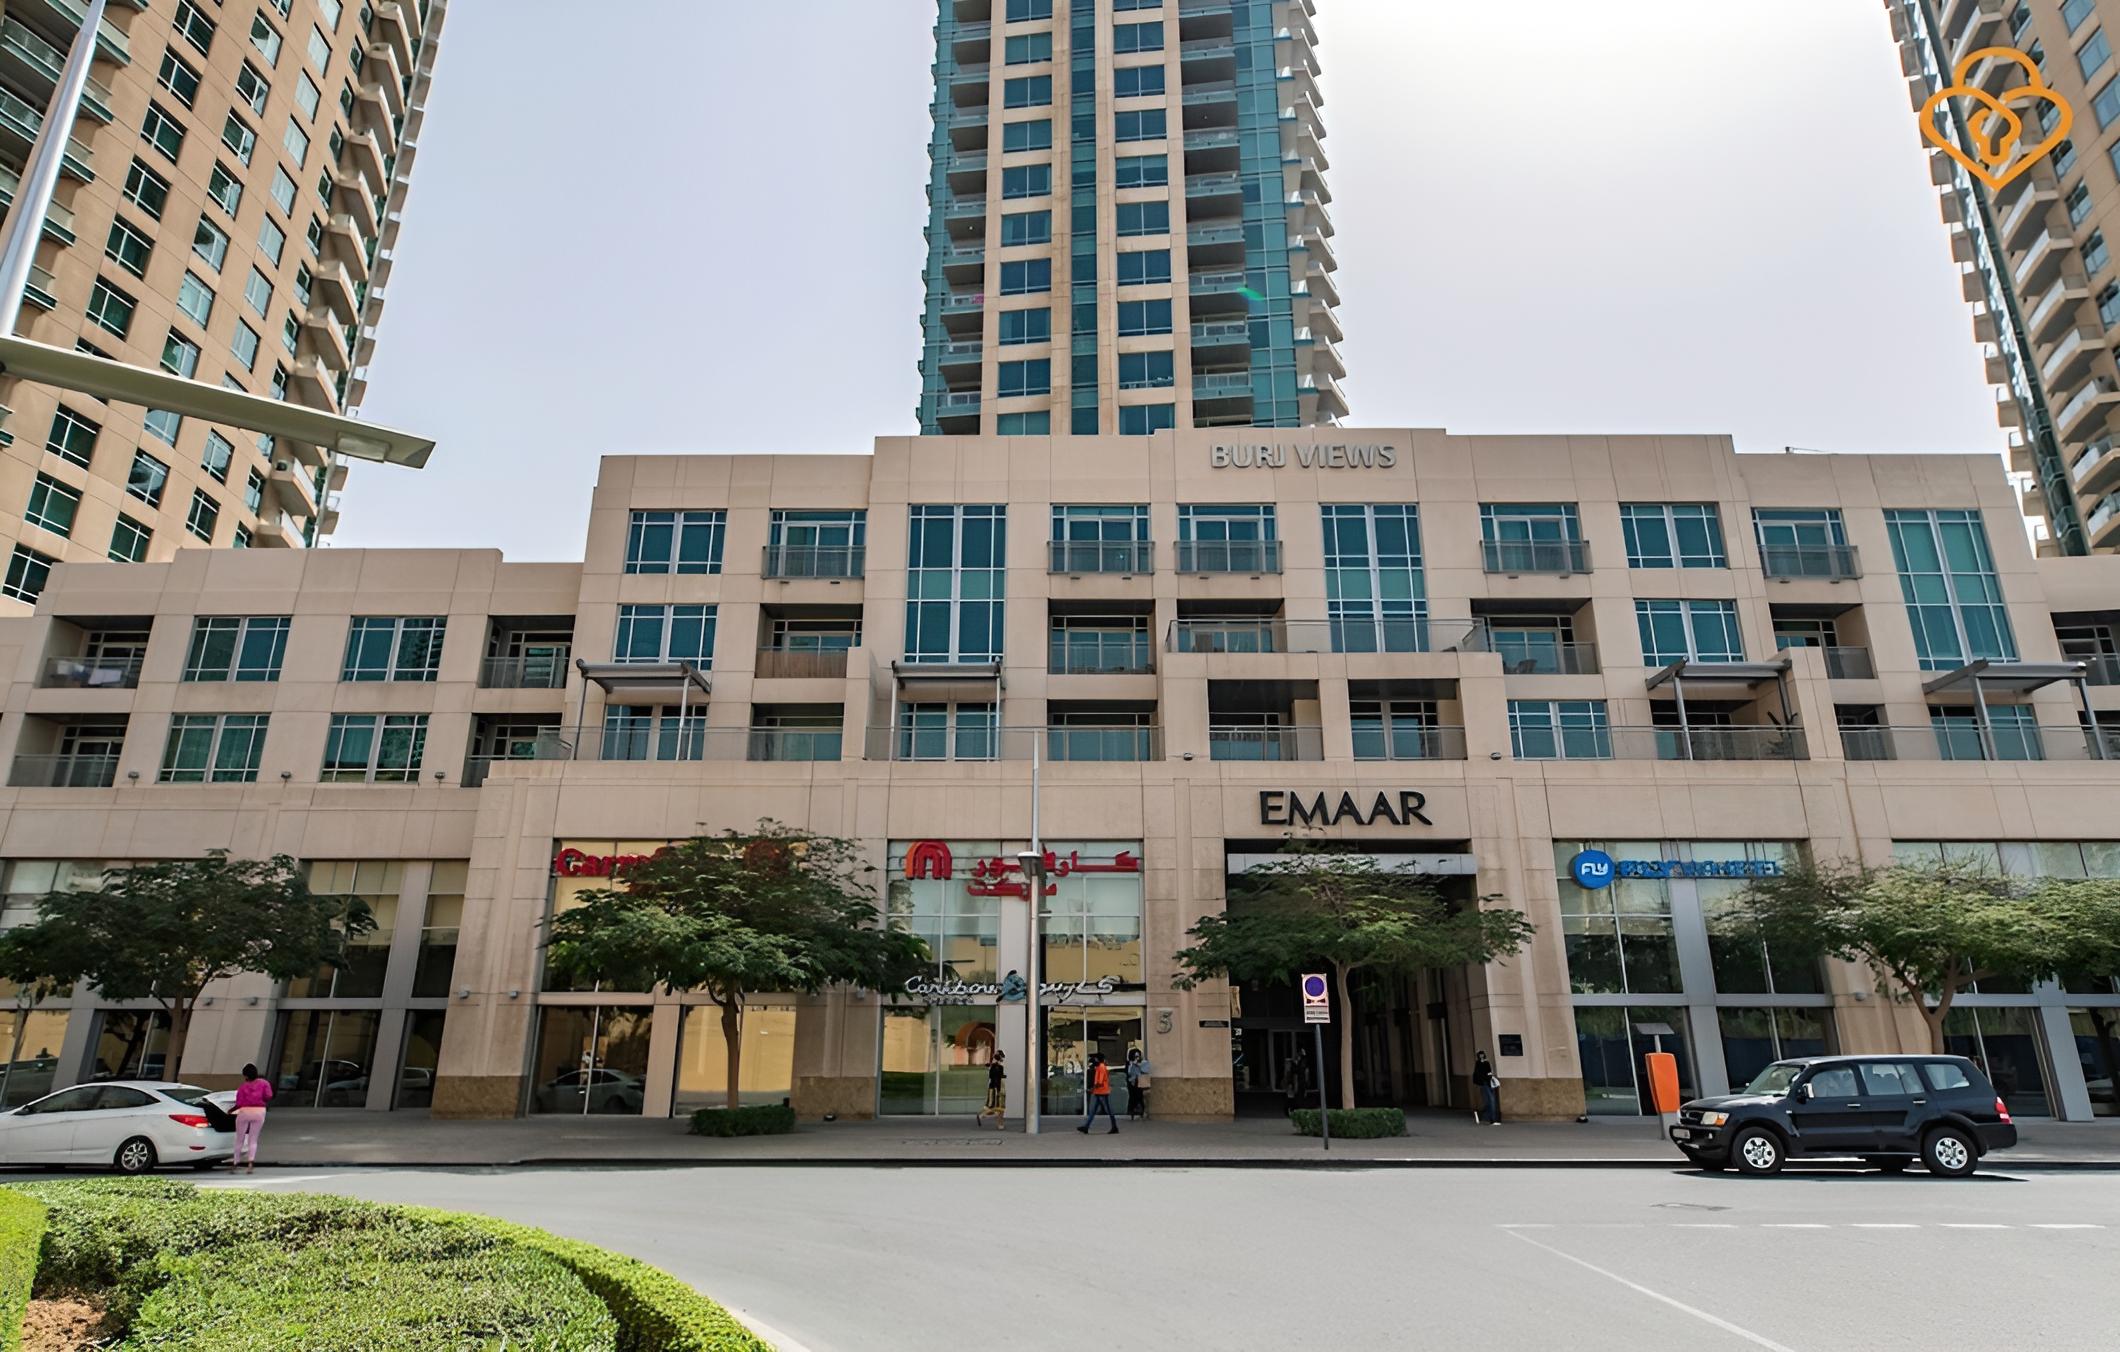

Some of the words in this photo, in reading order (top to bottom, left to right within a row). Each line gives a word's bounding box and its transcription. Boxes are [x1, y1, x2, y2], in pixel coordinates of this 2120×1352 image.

[1210, 443, 1287, 469] BURJ
[1294, 443, 1398, 469] VIEWS
[1258, 790, 1433, 826] EMAAR
